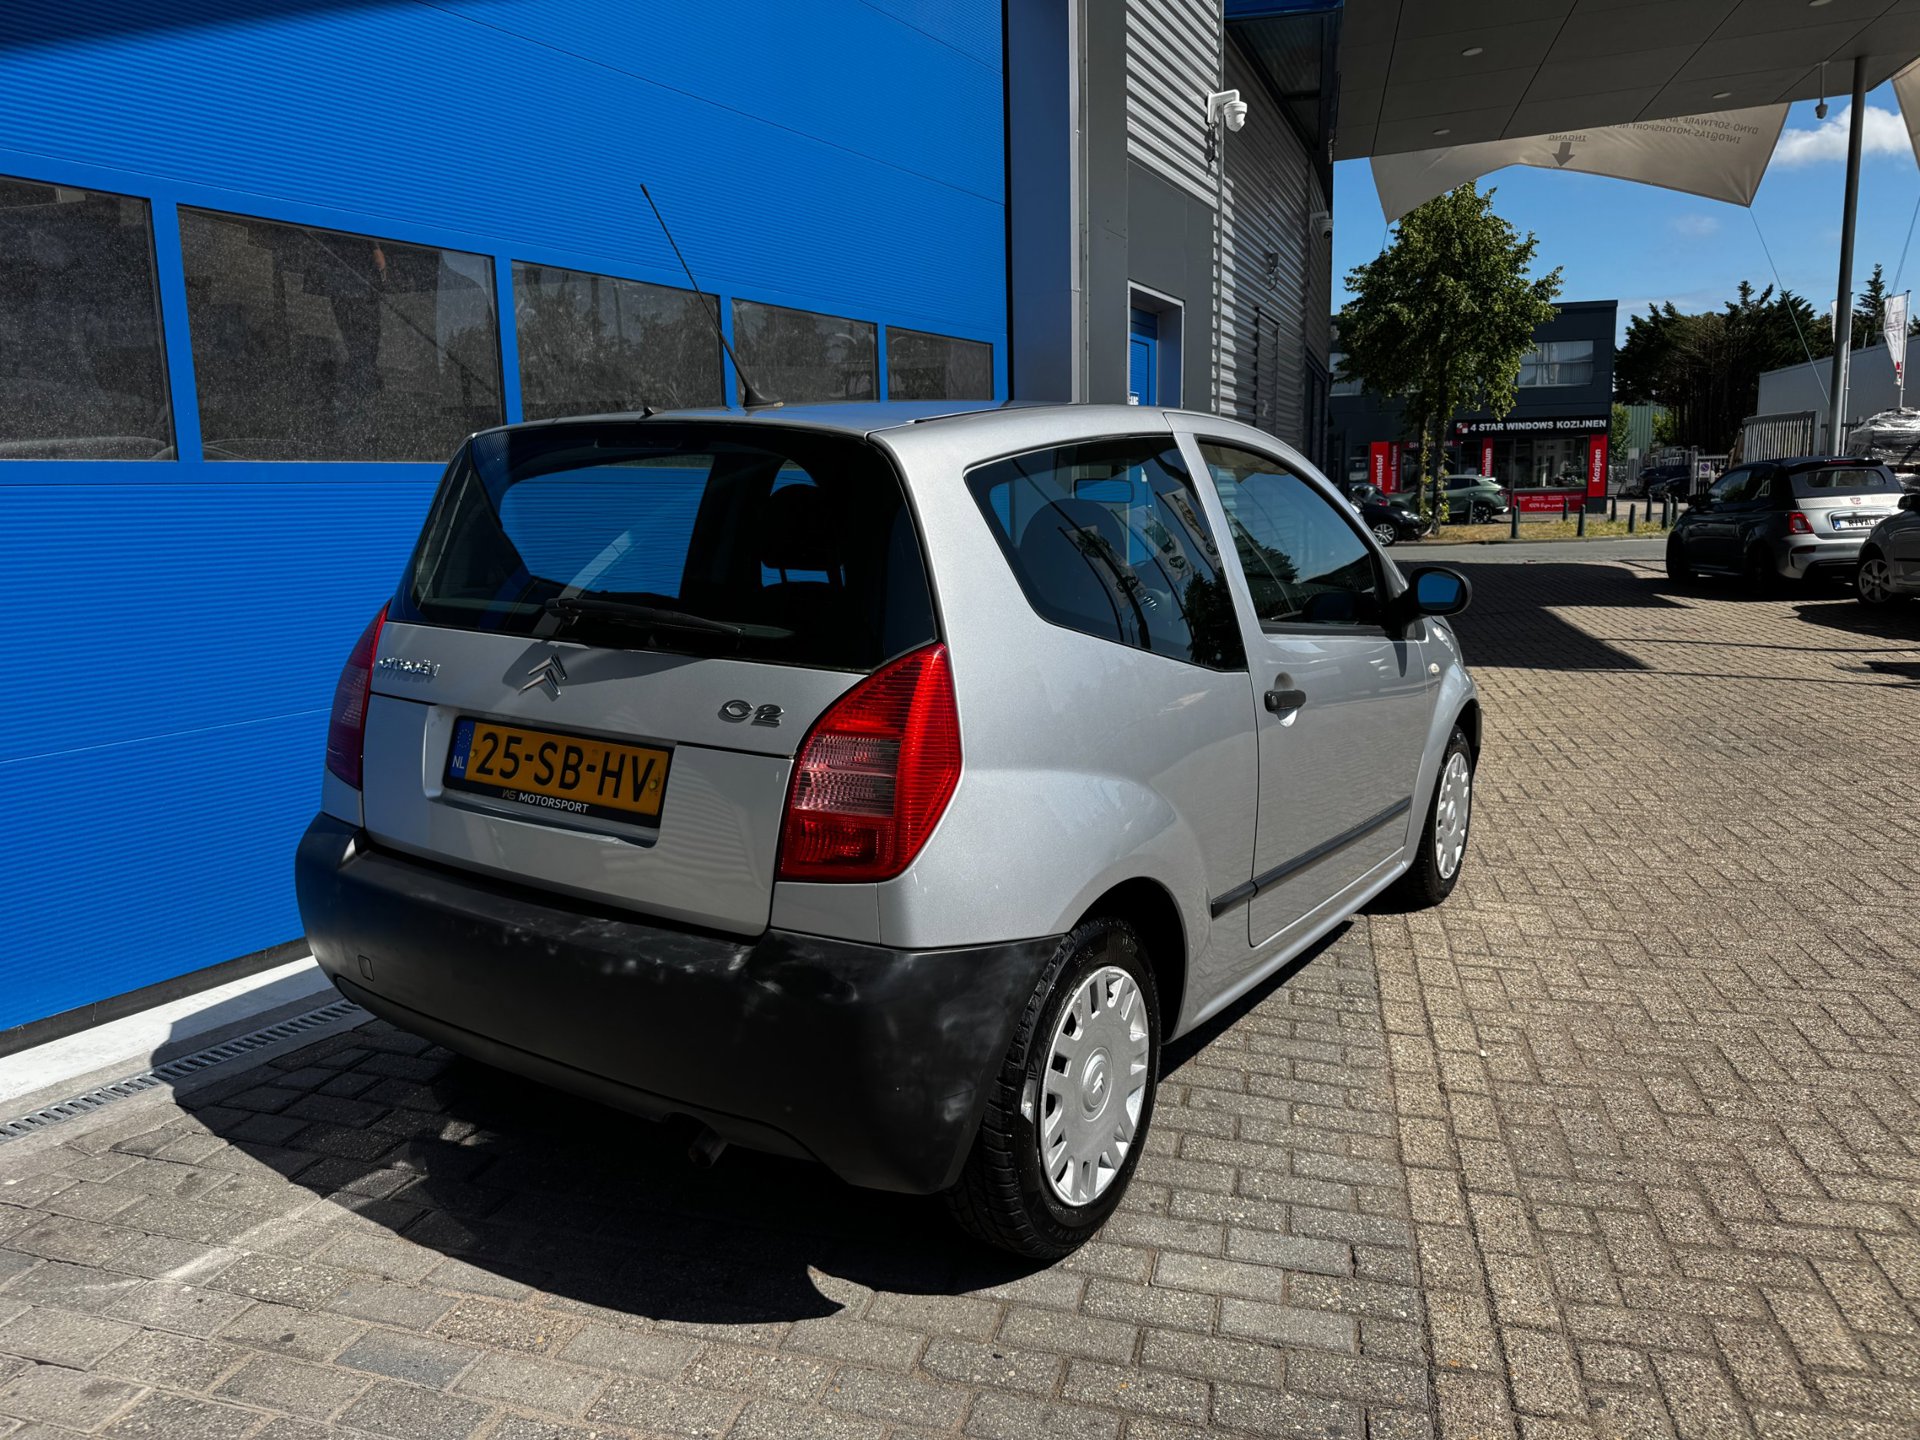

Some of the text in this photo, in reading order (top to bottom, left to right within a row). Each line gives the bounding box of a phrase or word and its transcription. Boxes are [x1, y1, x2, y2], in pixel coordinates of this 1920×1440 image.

[1470, 419, 1607, 432] 4 STAR WINDOWS KOZIJNEN
[1592, 448, 1602, 483] Kozijnen
[719, 699, 785, 727] C2
[452, 755, 465, 770] NL
[475, 731, 656, 803] 25-SB-HV
[518, 792, 590, 814] MOTORSPORT
